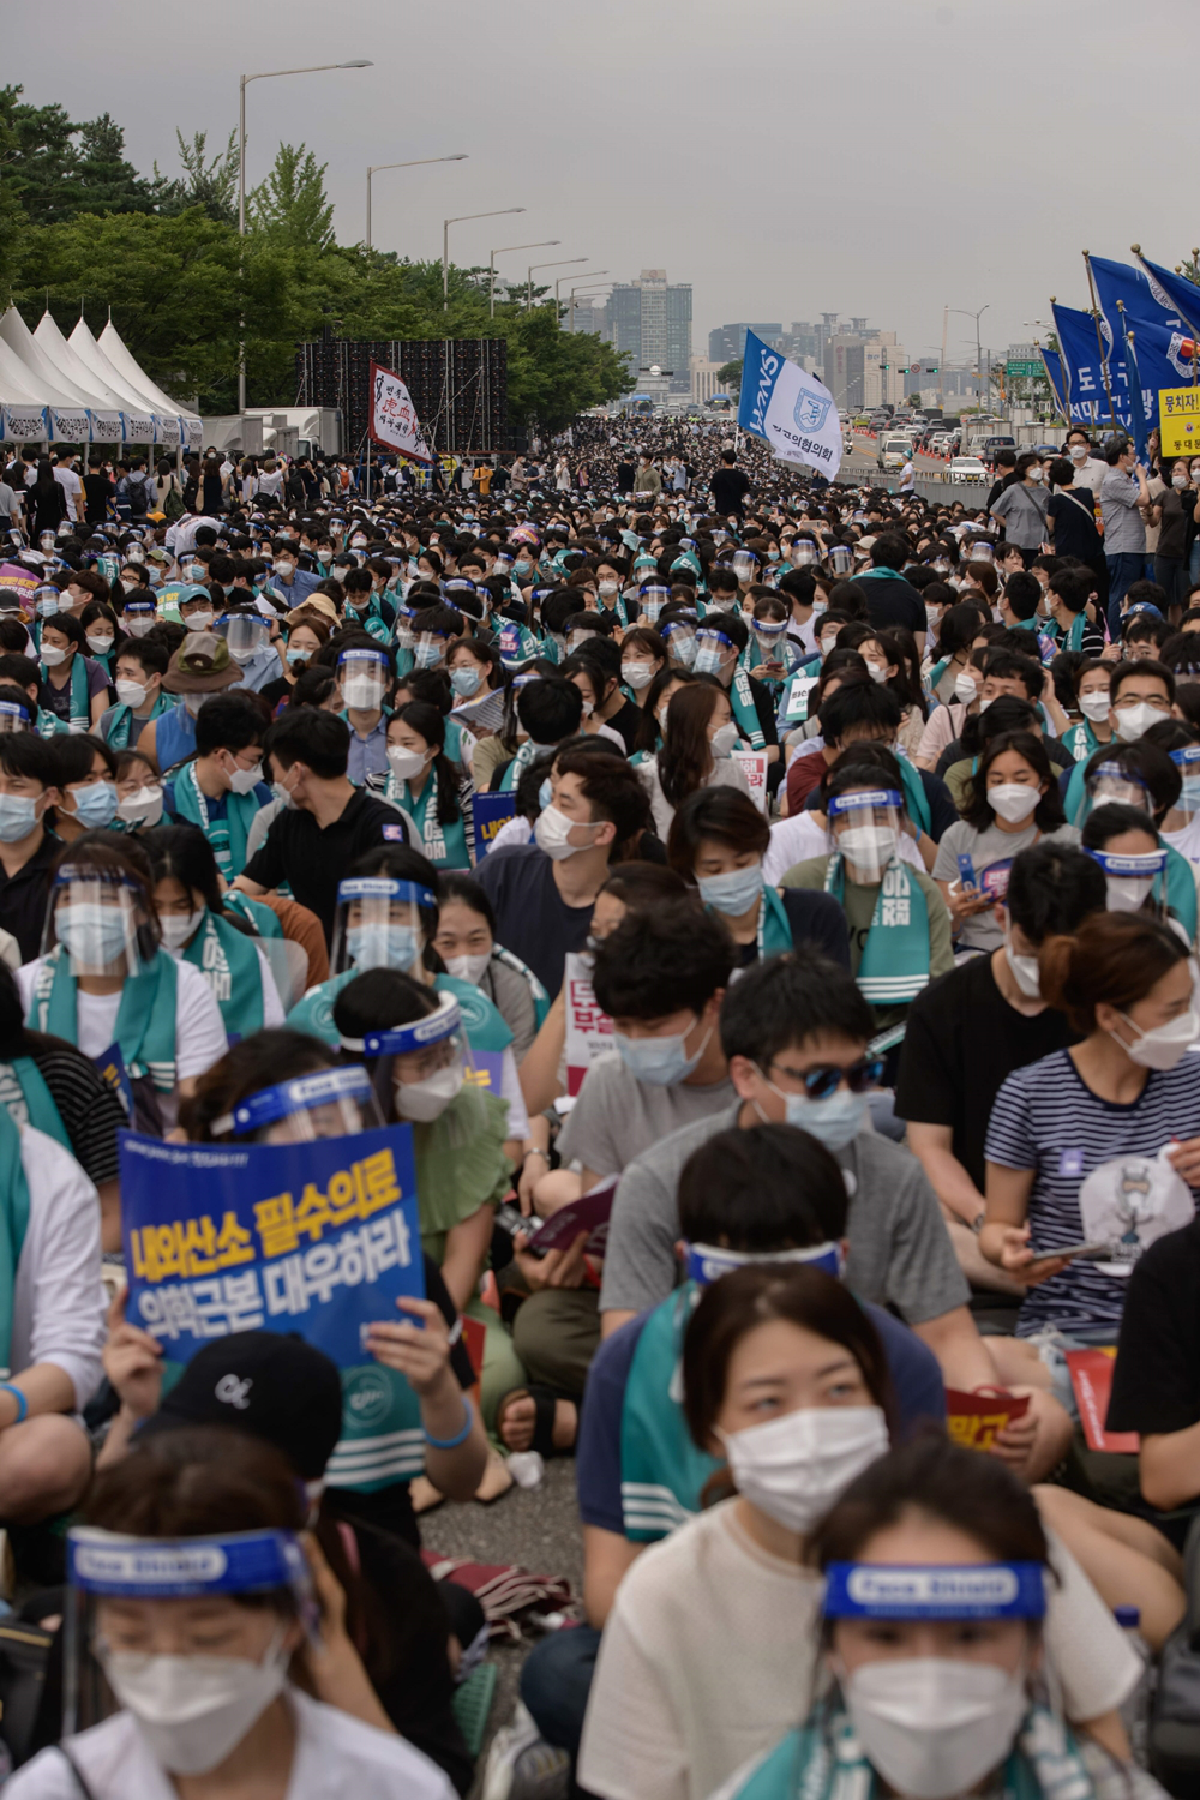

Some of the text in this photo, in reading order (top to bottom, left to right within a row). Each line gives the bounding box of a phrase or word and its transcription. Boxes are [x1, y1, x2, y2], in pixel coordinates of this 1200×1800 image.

[1164, 394, 1200, 413] 뭉치자!
[130, 1147, 402, 1283] 내외산소 필수의료
[263, 1208, 412, 1315] 대우하라
